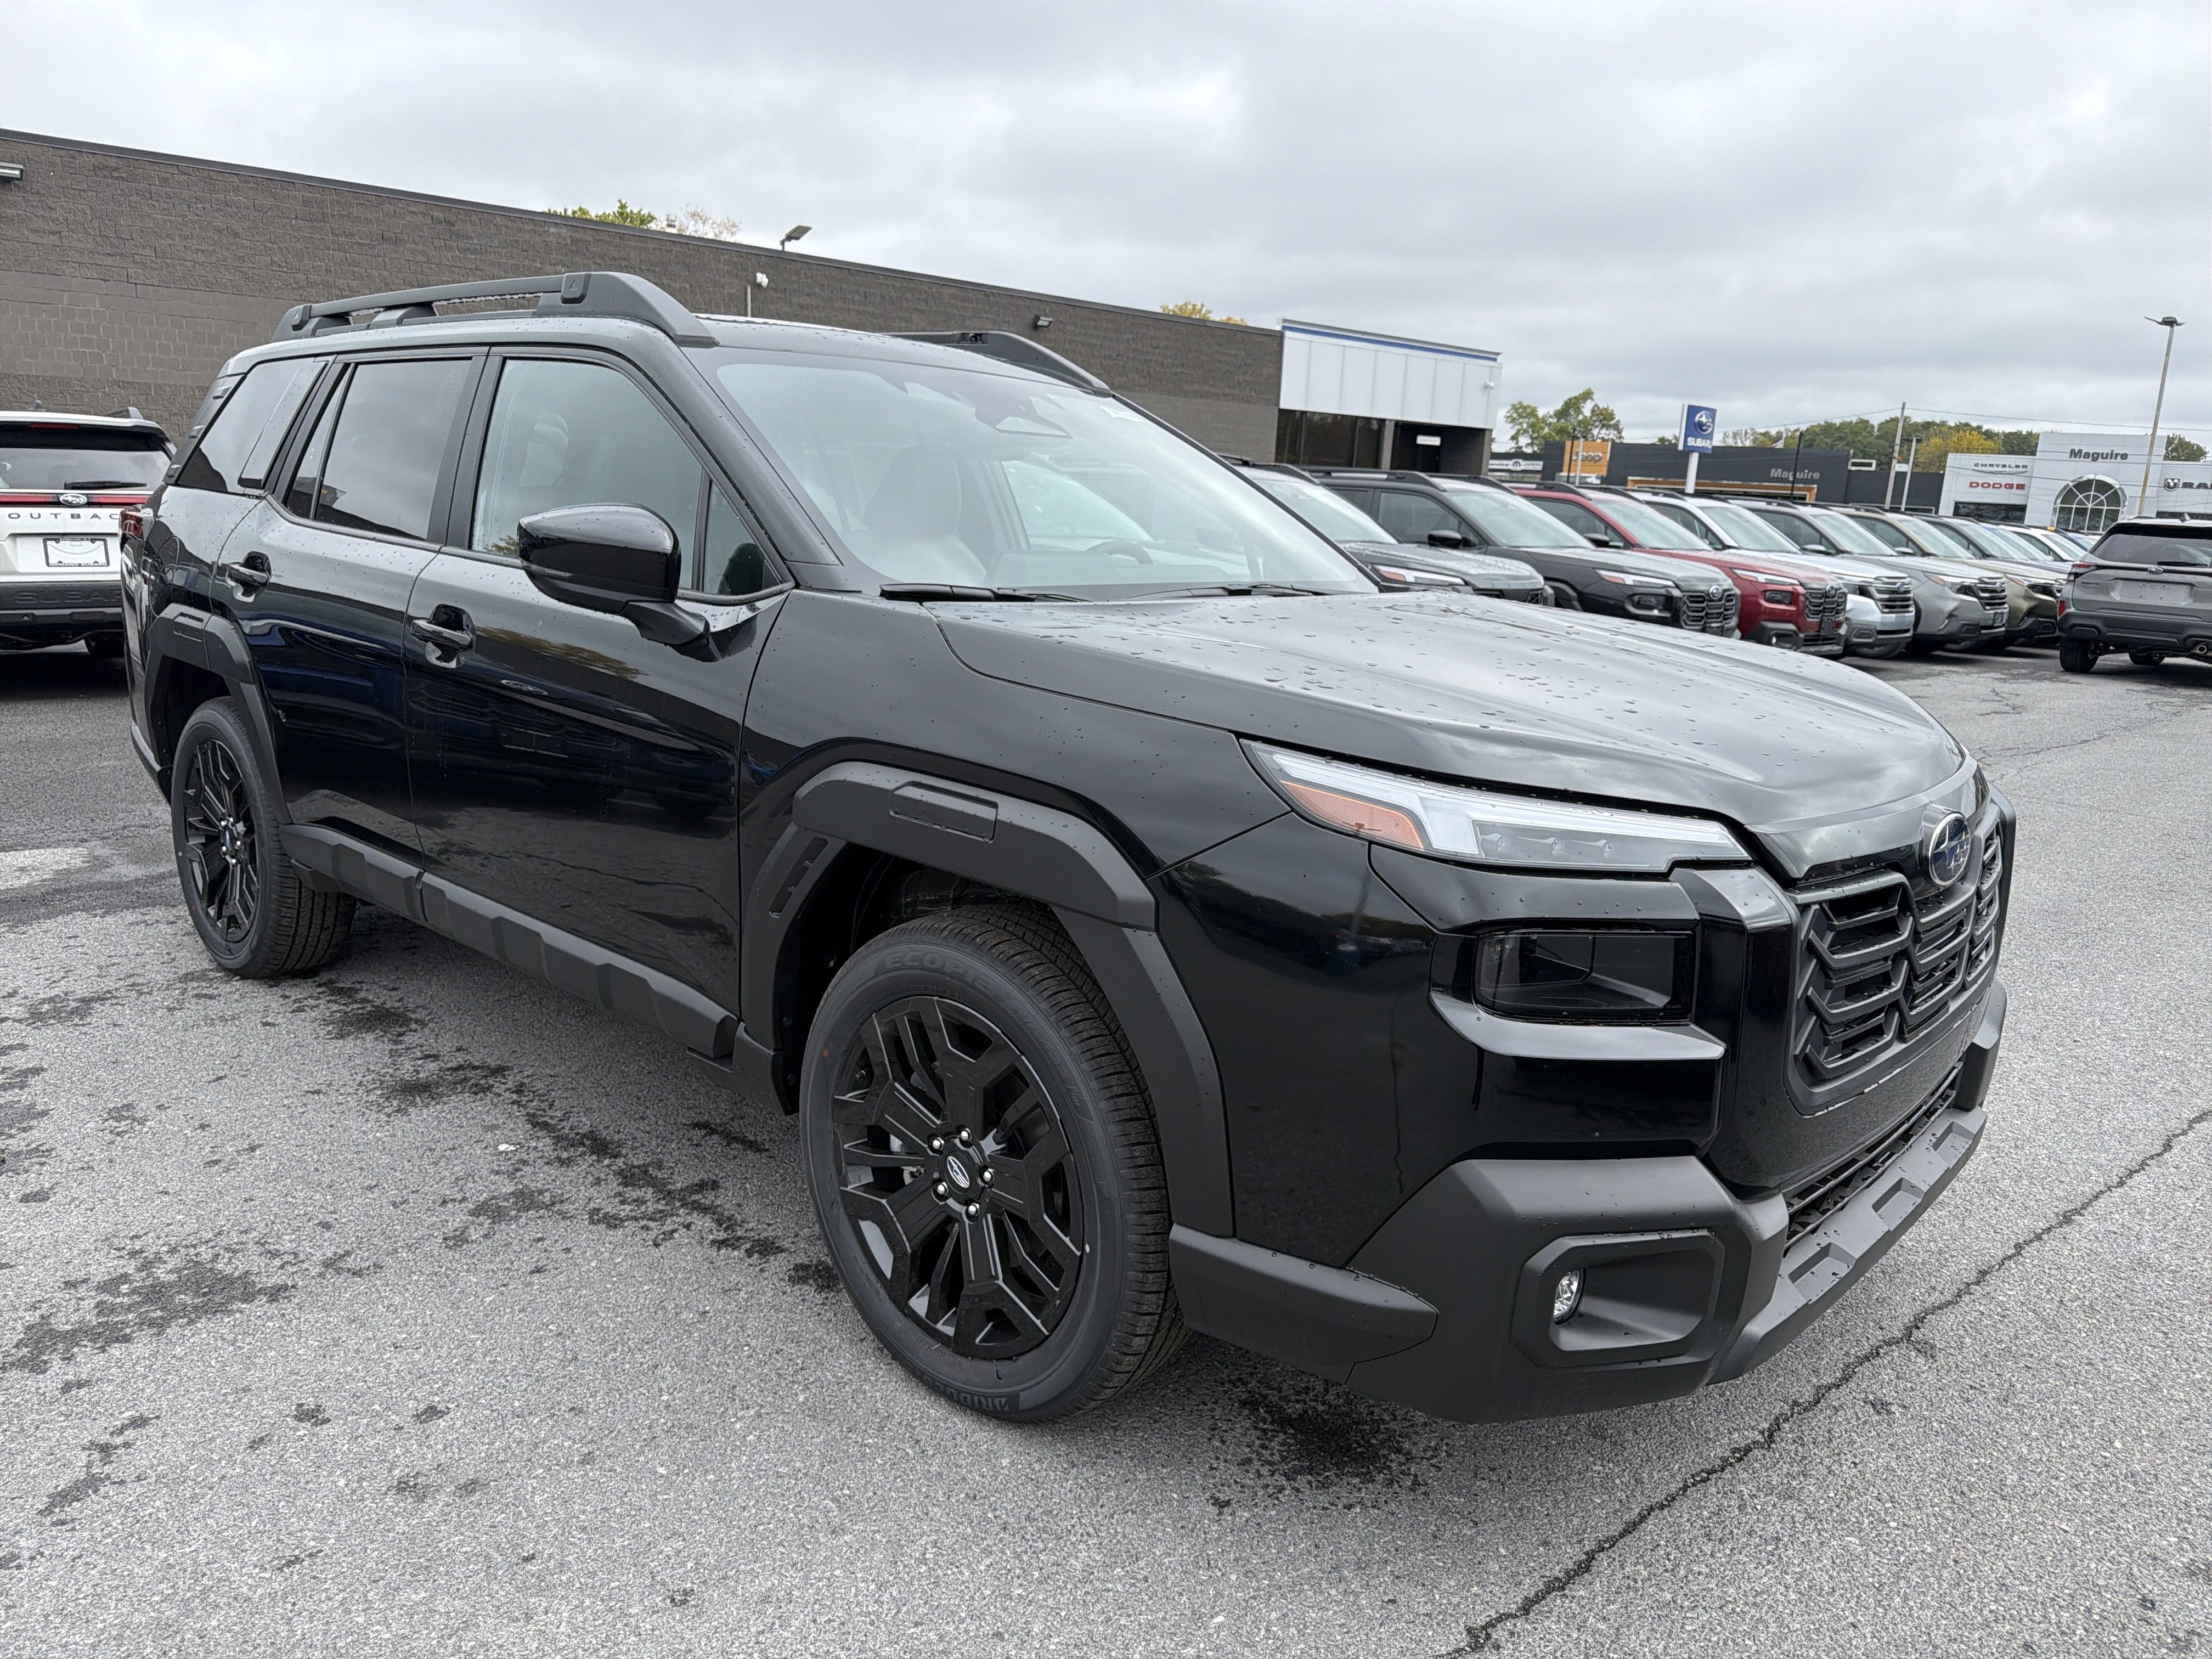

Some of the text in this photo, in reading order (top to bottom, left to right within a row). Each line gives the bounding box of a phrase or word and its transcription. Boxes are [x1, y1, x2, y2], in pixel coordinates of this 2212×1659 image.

[1687, 437, 1712, 449] SUBAR
[2069, 448, 2129, 461] Maguire
[1770, 468, 1820, 481] Maguire
[1969, 481, 2026, 490] DODGE
[15, 590, 122, 603] SUBA
